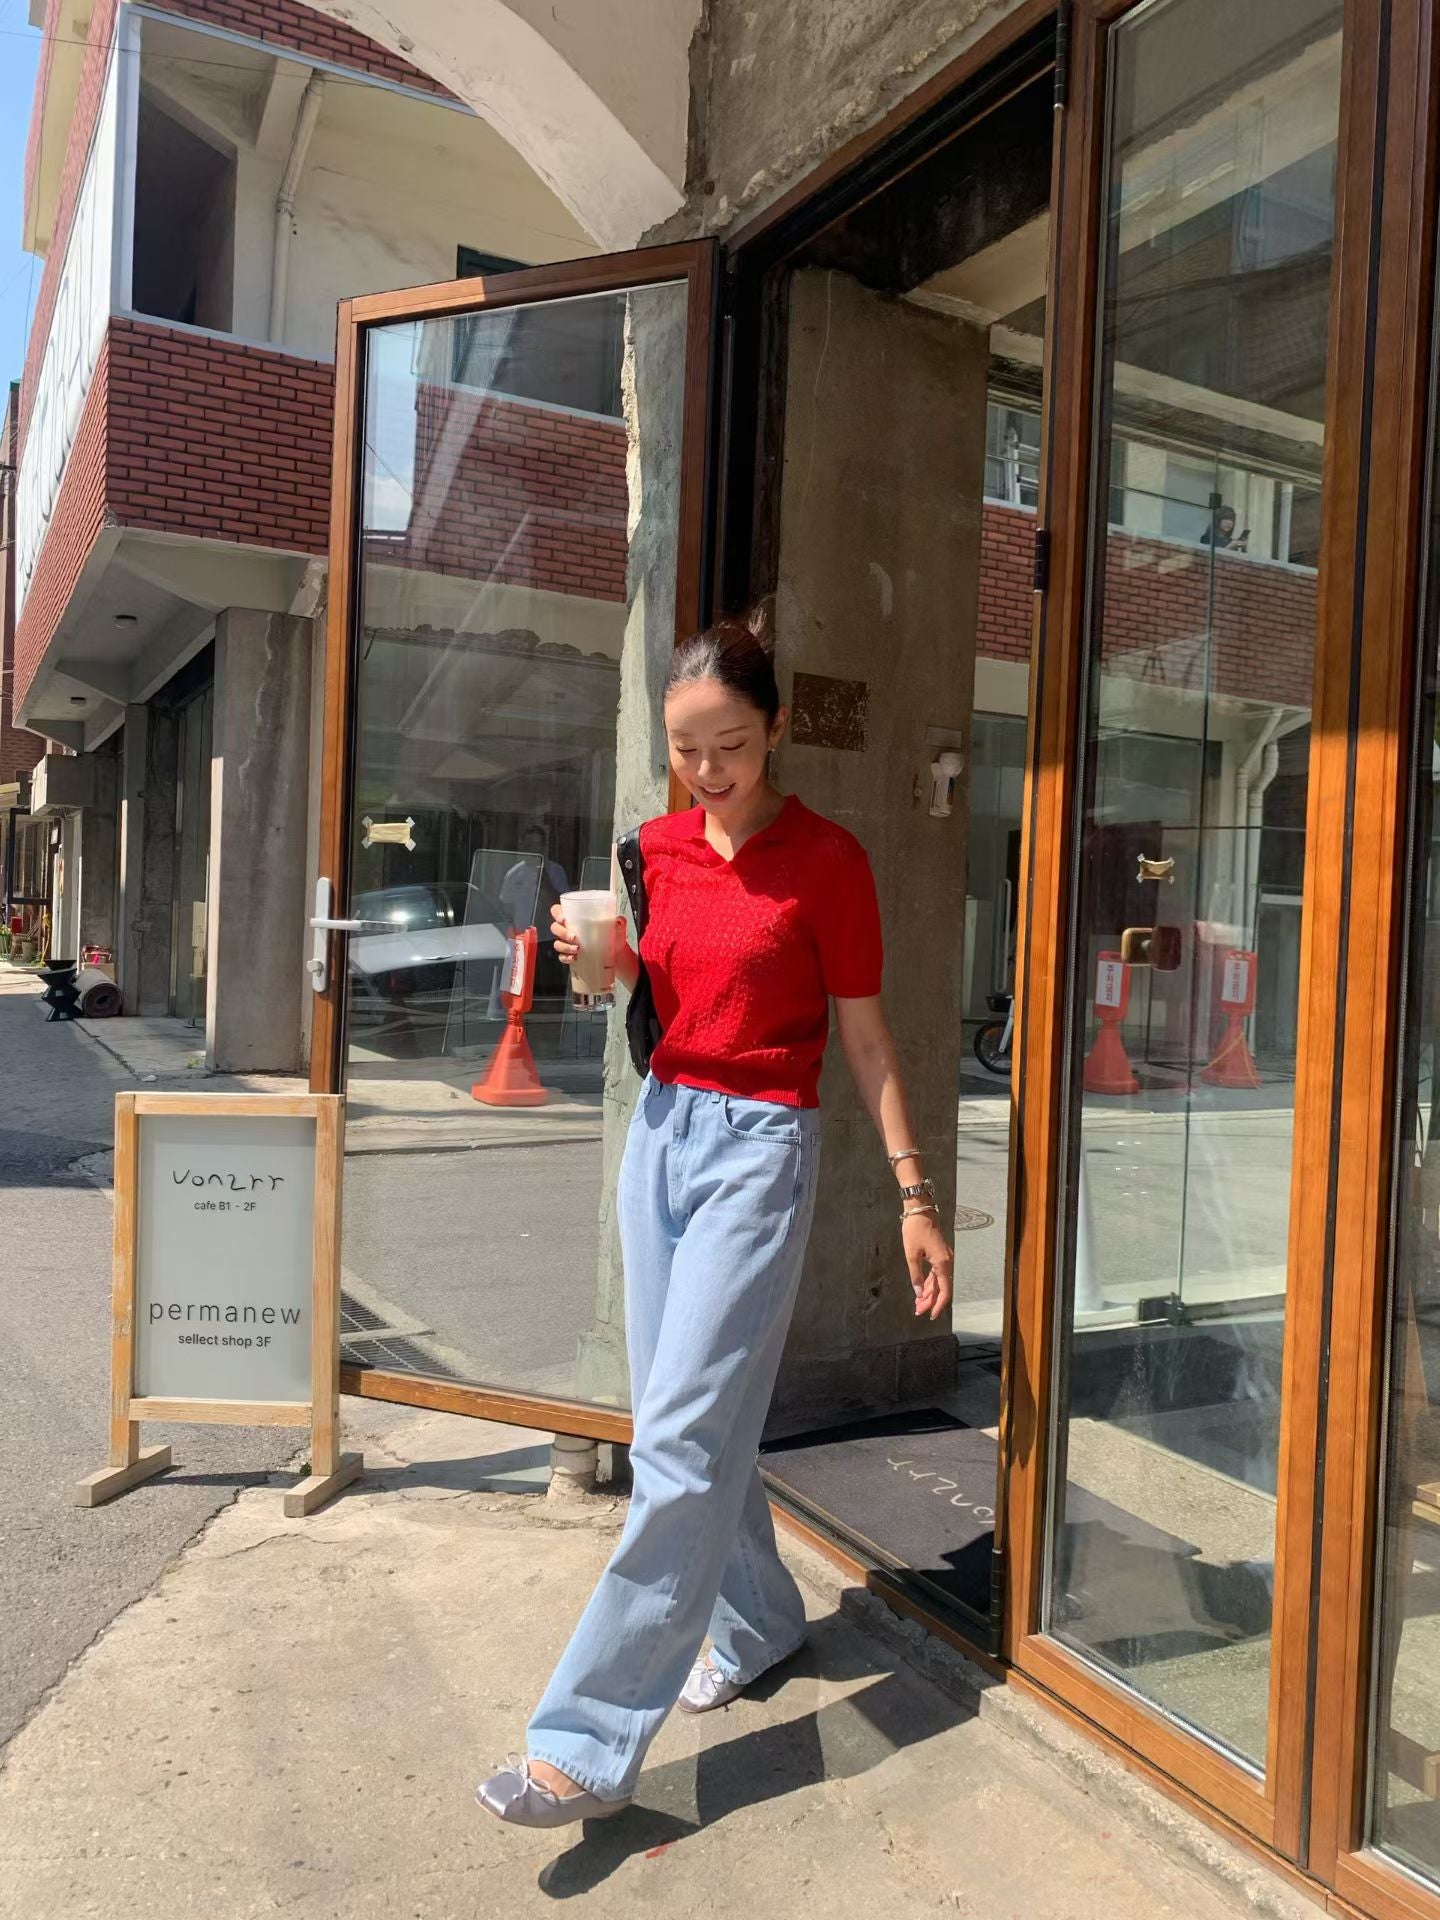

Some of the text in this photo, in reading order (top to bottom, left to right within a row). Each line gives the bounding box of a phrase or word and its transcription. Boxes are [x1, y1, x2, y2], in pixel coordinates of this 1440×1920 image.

[194, 1201, 216, 1210] cafe
[218, 1201, 230, 1210] B1
[243, 1202, 256, 1211] 2F
[149, 1302, 301, 1324] permanew
[178, 1334, 272, 1349] sellect shop 3F
